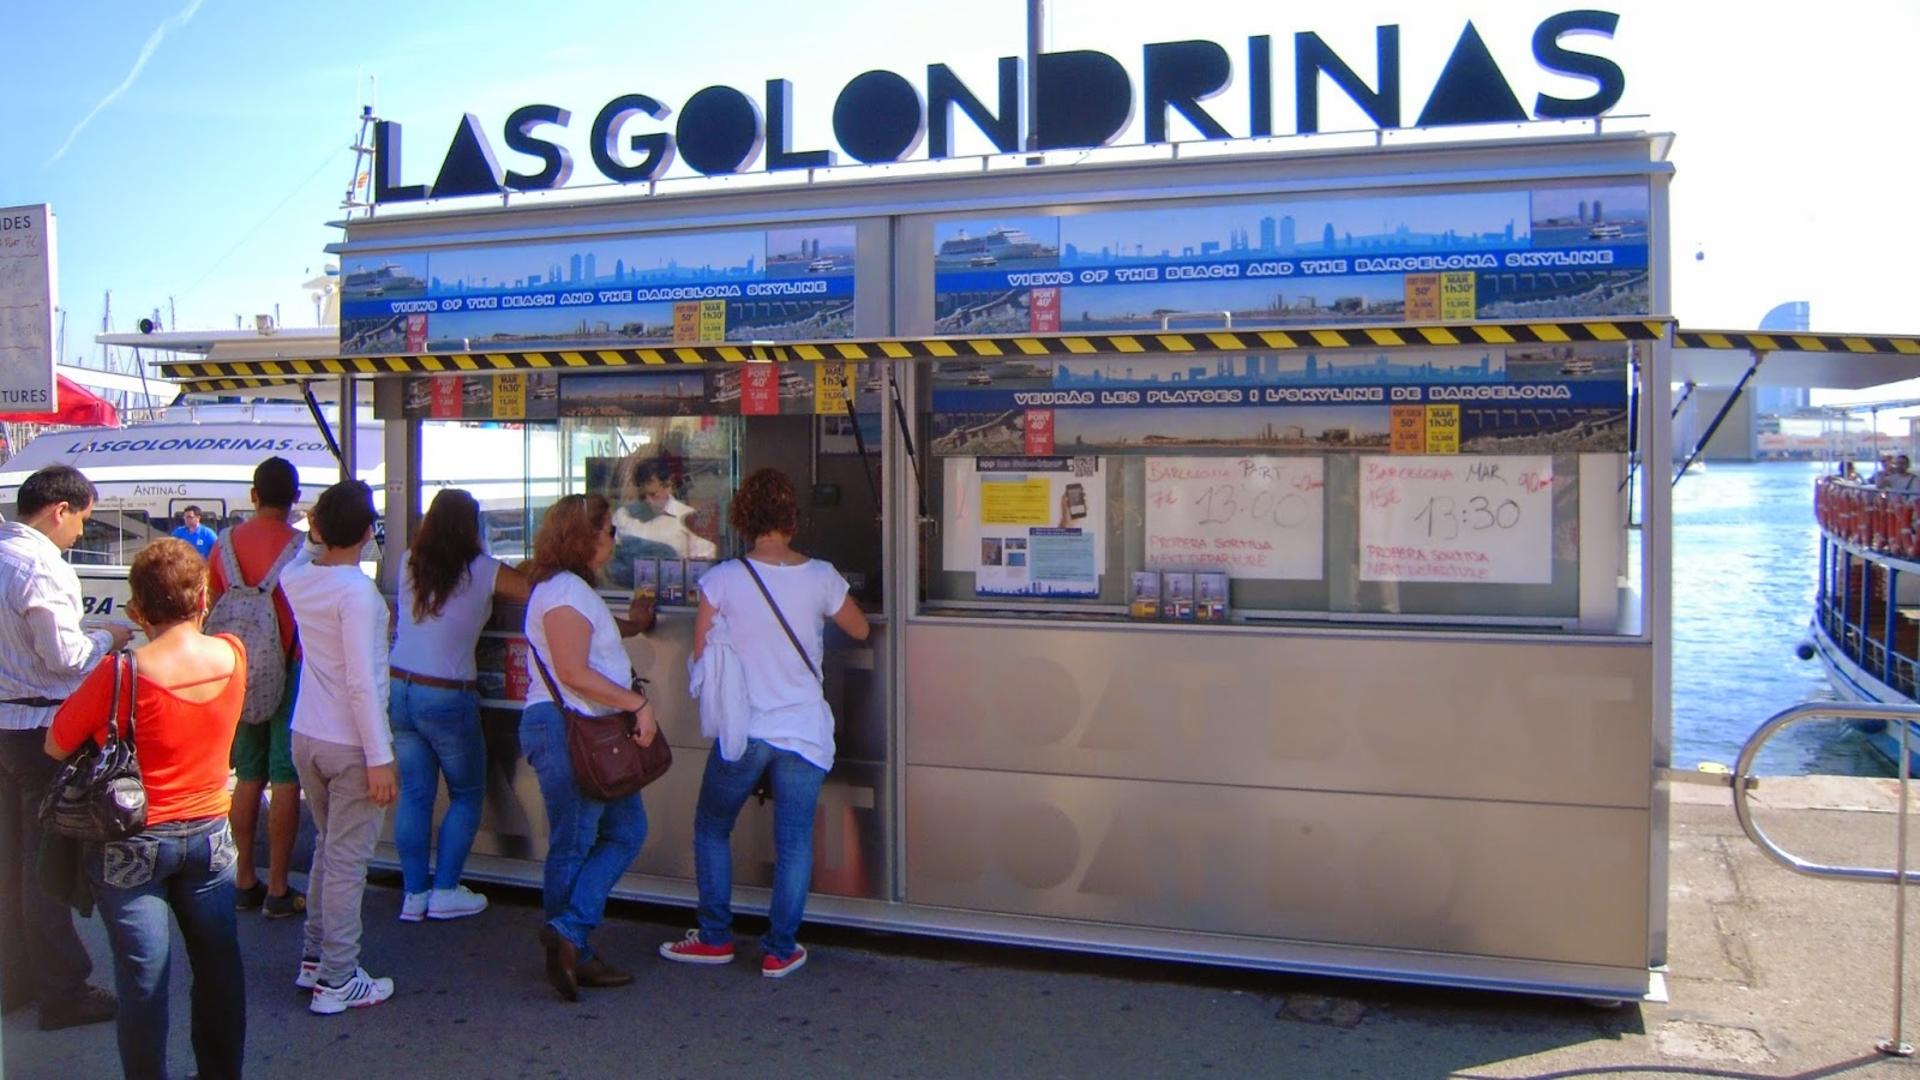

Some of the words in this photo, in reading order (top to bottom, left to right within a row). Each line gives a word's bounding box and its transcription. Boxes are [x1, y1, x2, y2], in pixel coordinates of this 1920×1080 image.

[375, 104, 573, 203] LAS
[590, 9, 1626, 184] GOLONDRINAS
[1007, 272, 1073, 286] VIEWS
[1080, 270, 1108, 283] OF
[1115, 268, 1158, 281] THE
[1165, 264, 1239, 279] BEACH
[1246, 262, 1294, 276] AND
[1301, 259, 1348, 274] THE
[1354, 253, 1498, 272] BARCELONA
[1504, 250, 1614, 267] SKYLINE
[391, 300, 438, 313] VIEWS
[442, 298, 463, 310] OF
[466, 297, 498, 309] THE
[502, 294, 556, 308] BEACH
[560, 291, 594, 305] AND
[599, 290, 632, 302] THE
[637, 284, 742, 300] BARCELONA
[747, 280, 828, 296] SKYLINE
[2, 389, 47, 403] TURES
[1014, 390, 1095, 405] VEURÀS
[1101, 390, 1140, 404] LES
[1147, 388, 1242, 403] PLATGES
[1249, 389, 1260, 402] I
[1390, 386, 1422, 401] DE
[1428, 384, 1572, 400] BARCELONA
[1465, 462, 1508, 485] MAR
[1414, 495, 1521, 541] 13:30
